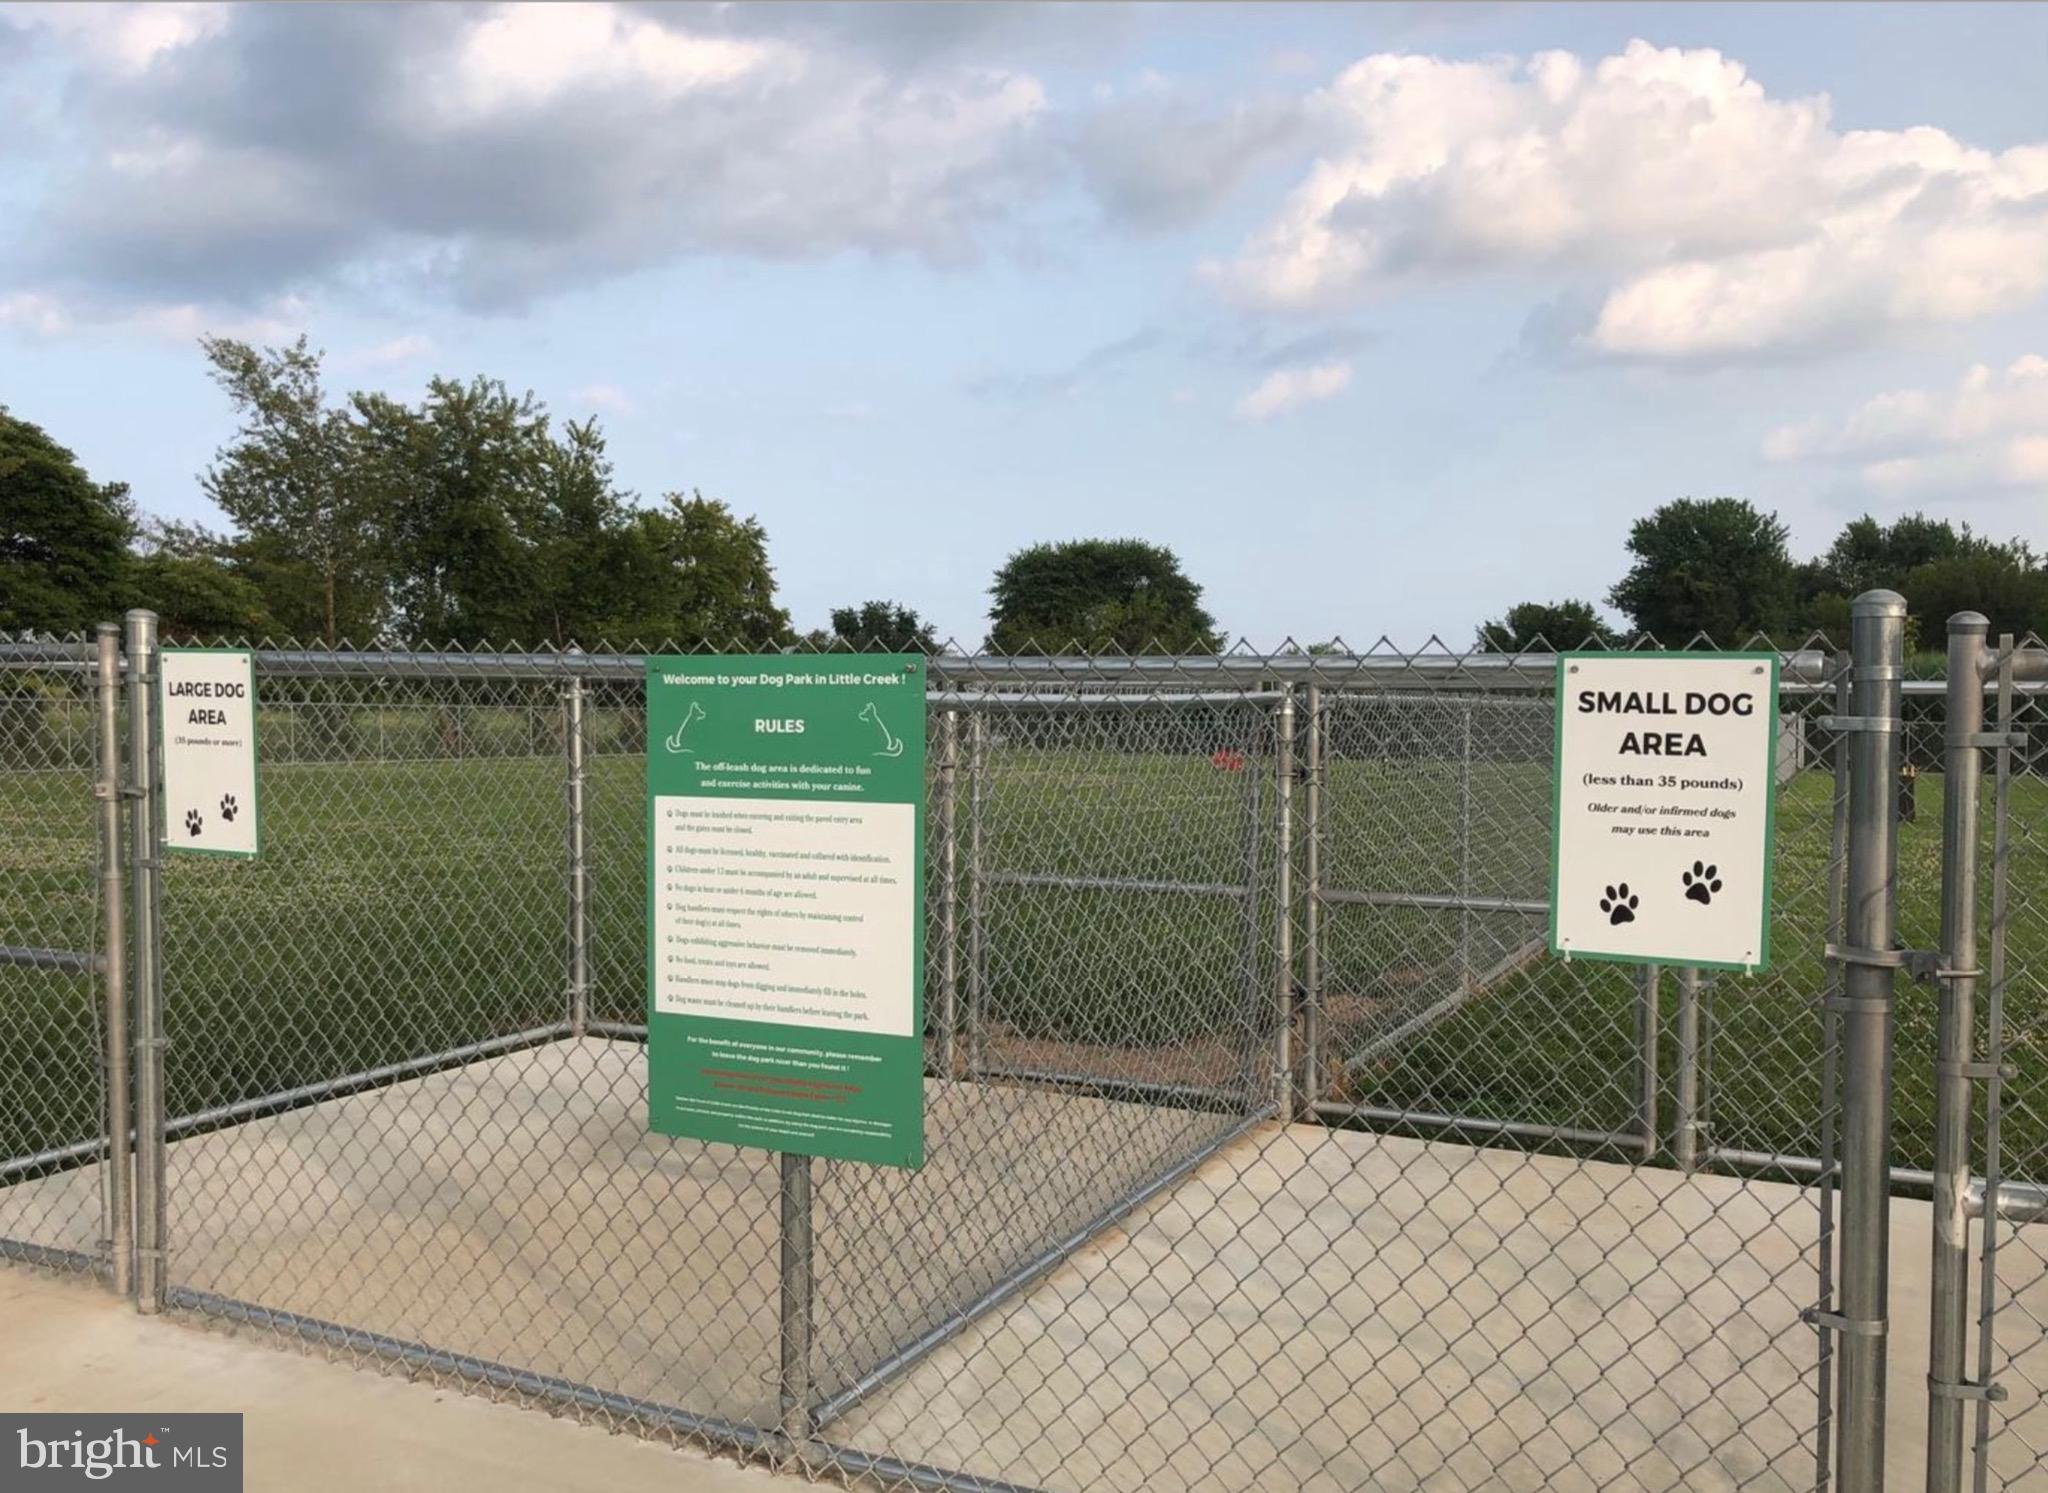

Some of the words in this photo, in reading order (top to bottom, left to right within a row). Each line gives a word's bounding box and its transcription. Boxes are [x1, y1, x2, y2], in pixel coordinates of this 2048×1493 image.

[662, 674, 715, 684] Welcome
[716, 674, 730, 684] to
[731, 676, 757, 686] your
[758, 674, 783, 686] Dog
[785, 674, 813, 684] Park
[814, 674, 827, 684] in
[828, 674, 861, 684] Little
[862, 674, 900, 684] Creek
[169, 682, 212, 697] LARGE
[214, 683, 245, 698] DOG
[1577, 691, 1677, 714] SMALL
[1685, 692, 1754, 716] DOG
[188, 709, 227, 725] AREA
[754, 719, 805, 733] RULES
[187, 737, 211, 746] pounds
[1618, 731, 1707, 757] AREA
[700, 779, 716, 788] and
[717, 780, 751, 788] exercise
[752, 780, 790, 790] activities
[791, 781, 810, 790] with
[811, 783, 831, 792] your
[832, 782, 865, 791] canine.
[1582, 773, 1617, 786] (less
[1620, 774, 1654, 787] than
[1658, 775, 1677, 788] 35
[1680, 776, 1744, 791] pounds)
[1587, 802, 1619, 813] Older
[1620, 804, 1657, 815] and/or
[1659, 805, 1707, 818] infirmed
[1709, 808, 1736, 819] dogs
[1611, 826, 1636, 835] may
[1637, 827, 1657, 836] use
[1660, 826, 1682, 836] this
[1684, 829, 1710, 838] area
